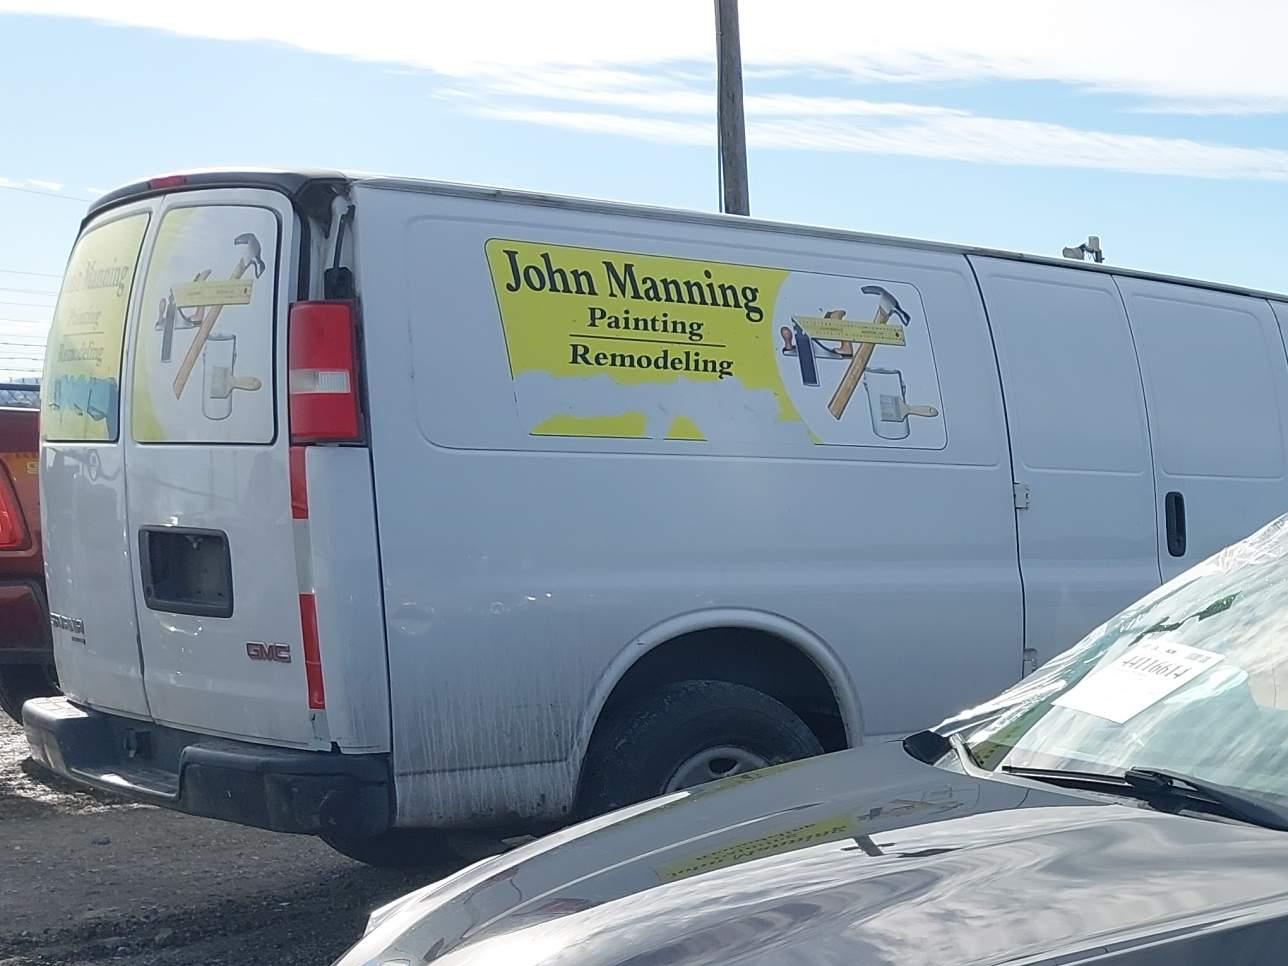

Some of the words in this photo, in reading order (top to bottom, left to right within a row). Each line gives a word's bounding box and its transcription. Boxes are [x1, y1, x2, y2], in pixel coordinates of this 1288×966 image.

[502, 249, 599, 296] John
[602, 261, 764, 323] Manning
[587, 306, 704, 341] Painting
[569, 343, 734, 379] Remodeling
[246, 642, 292, 663] GMC
